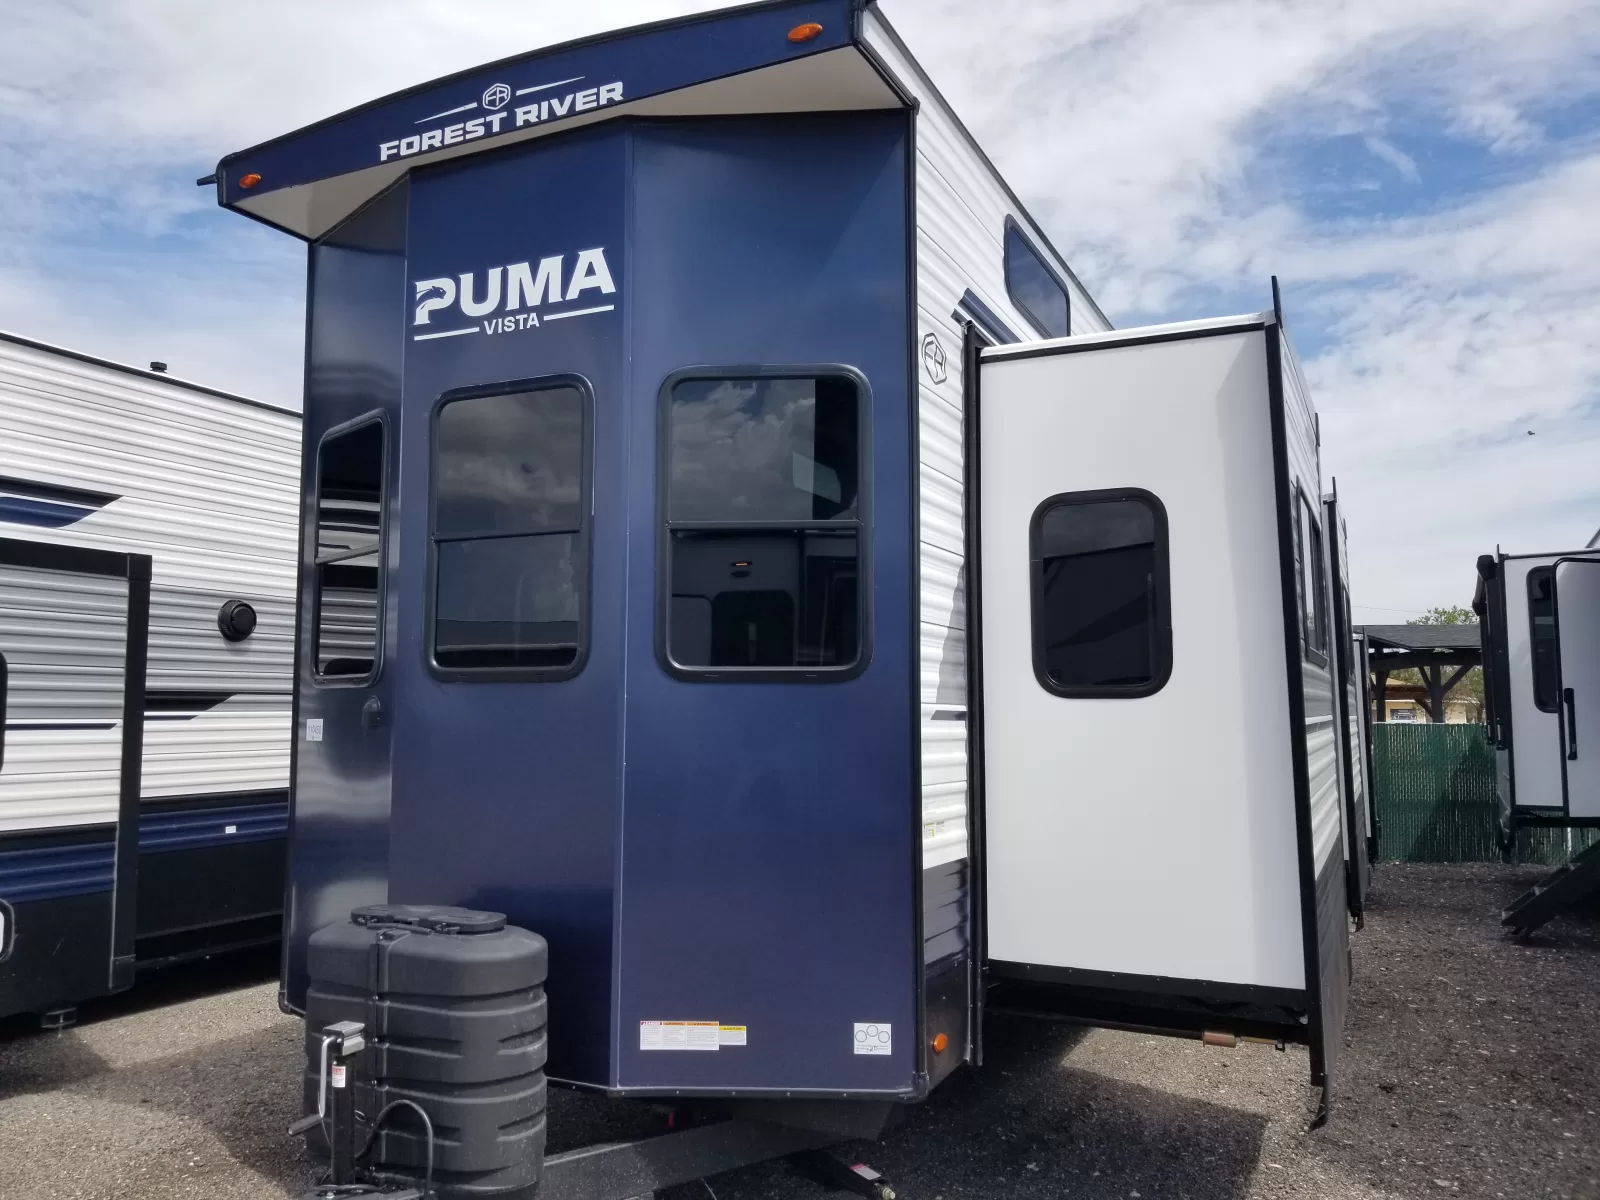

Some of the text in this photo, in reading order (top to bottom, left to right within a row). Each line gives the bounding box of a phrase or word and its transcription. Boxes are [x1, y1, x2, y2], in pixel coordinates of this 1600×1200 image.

[379, 81, 623, 161] FOREST RIVER
[413, 247, 616, 325] PUMA
[484, 312, 540, 335] VISTA
